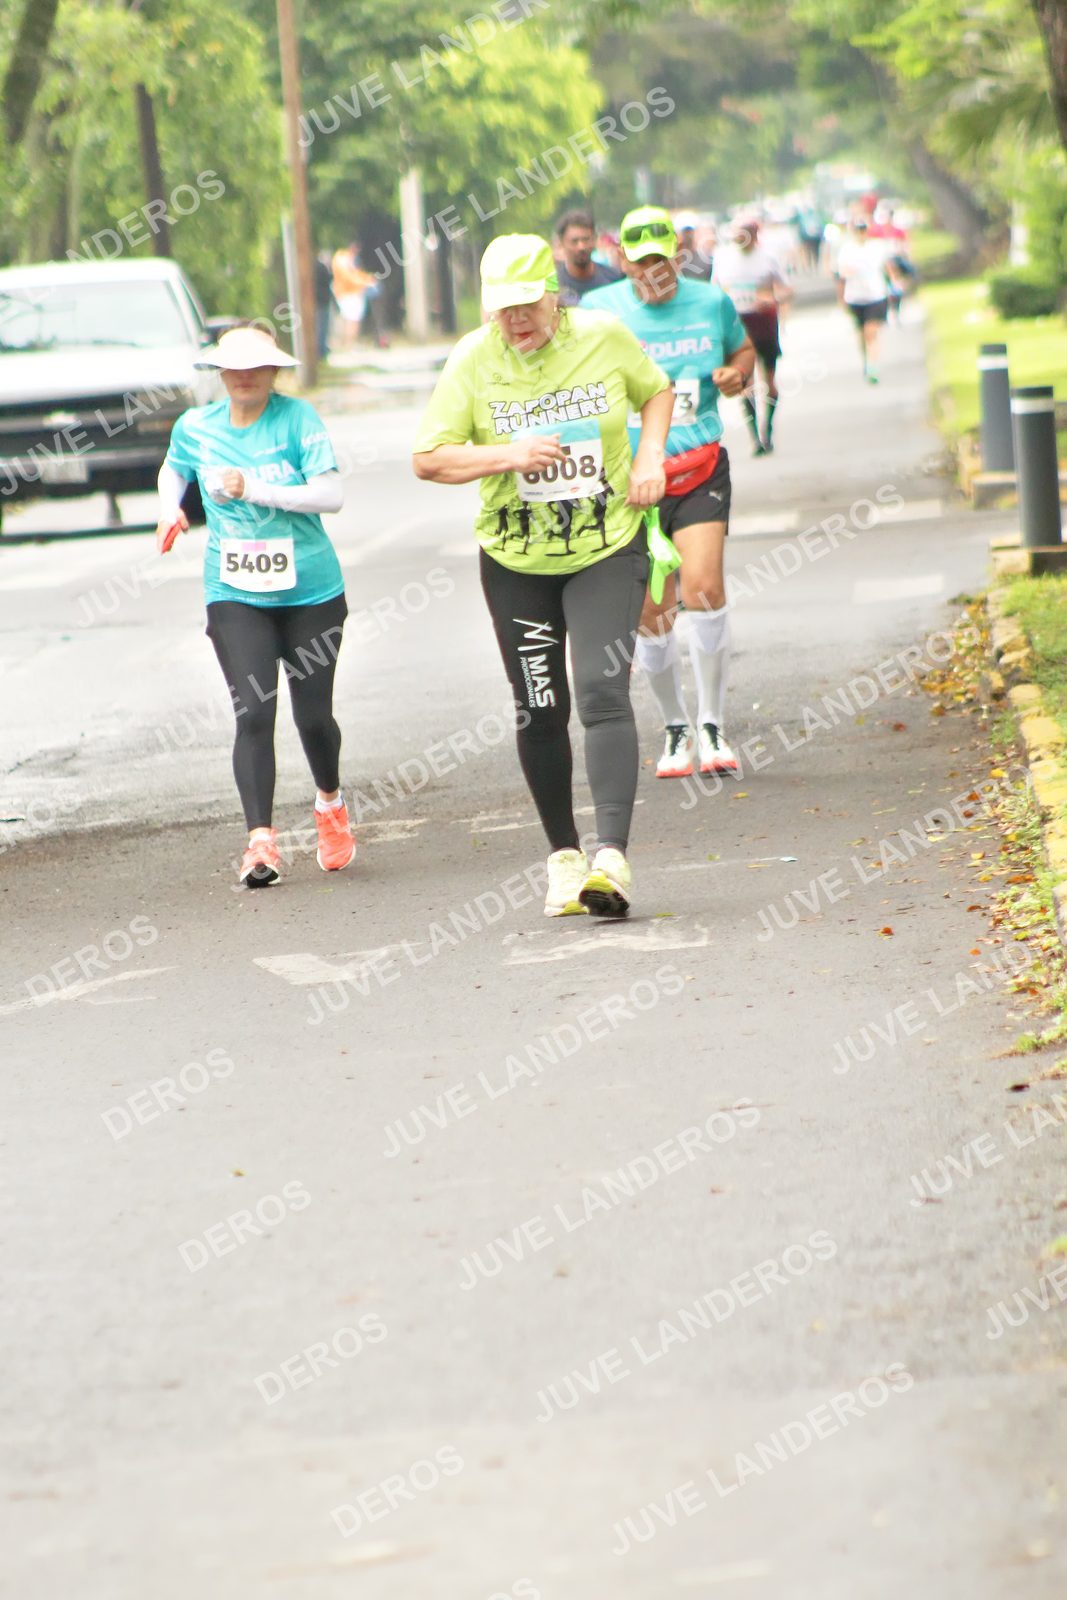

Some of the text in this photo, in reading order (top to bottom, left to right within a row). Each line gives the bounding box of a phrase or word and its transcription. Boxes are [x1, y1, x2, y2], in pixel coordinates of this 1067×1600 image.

[489, 381, 607, 418] ZAPOPAN
[494, 397, 609, 435] RUNNERS
[226, 552, 288, 574] 5409
[527, 654, 556, 708] MAS
